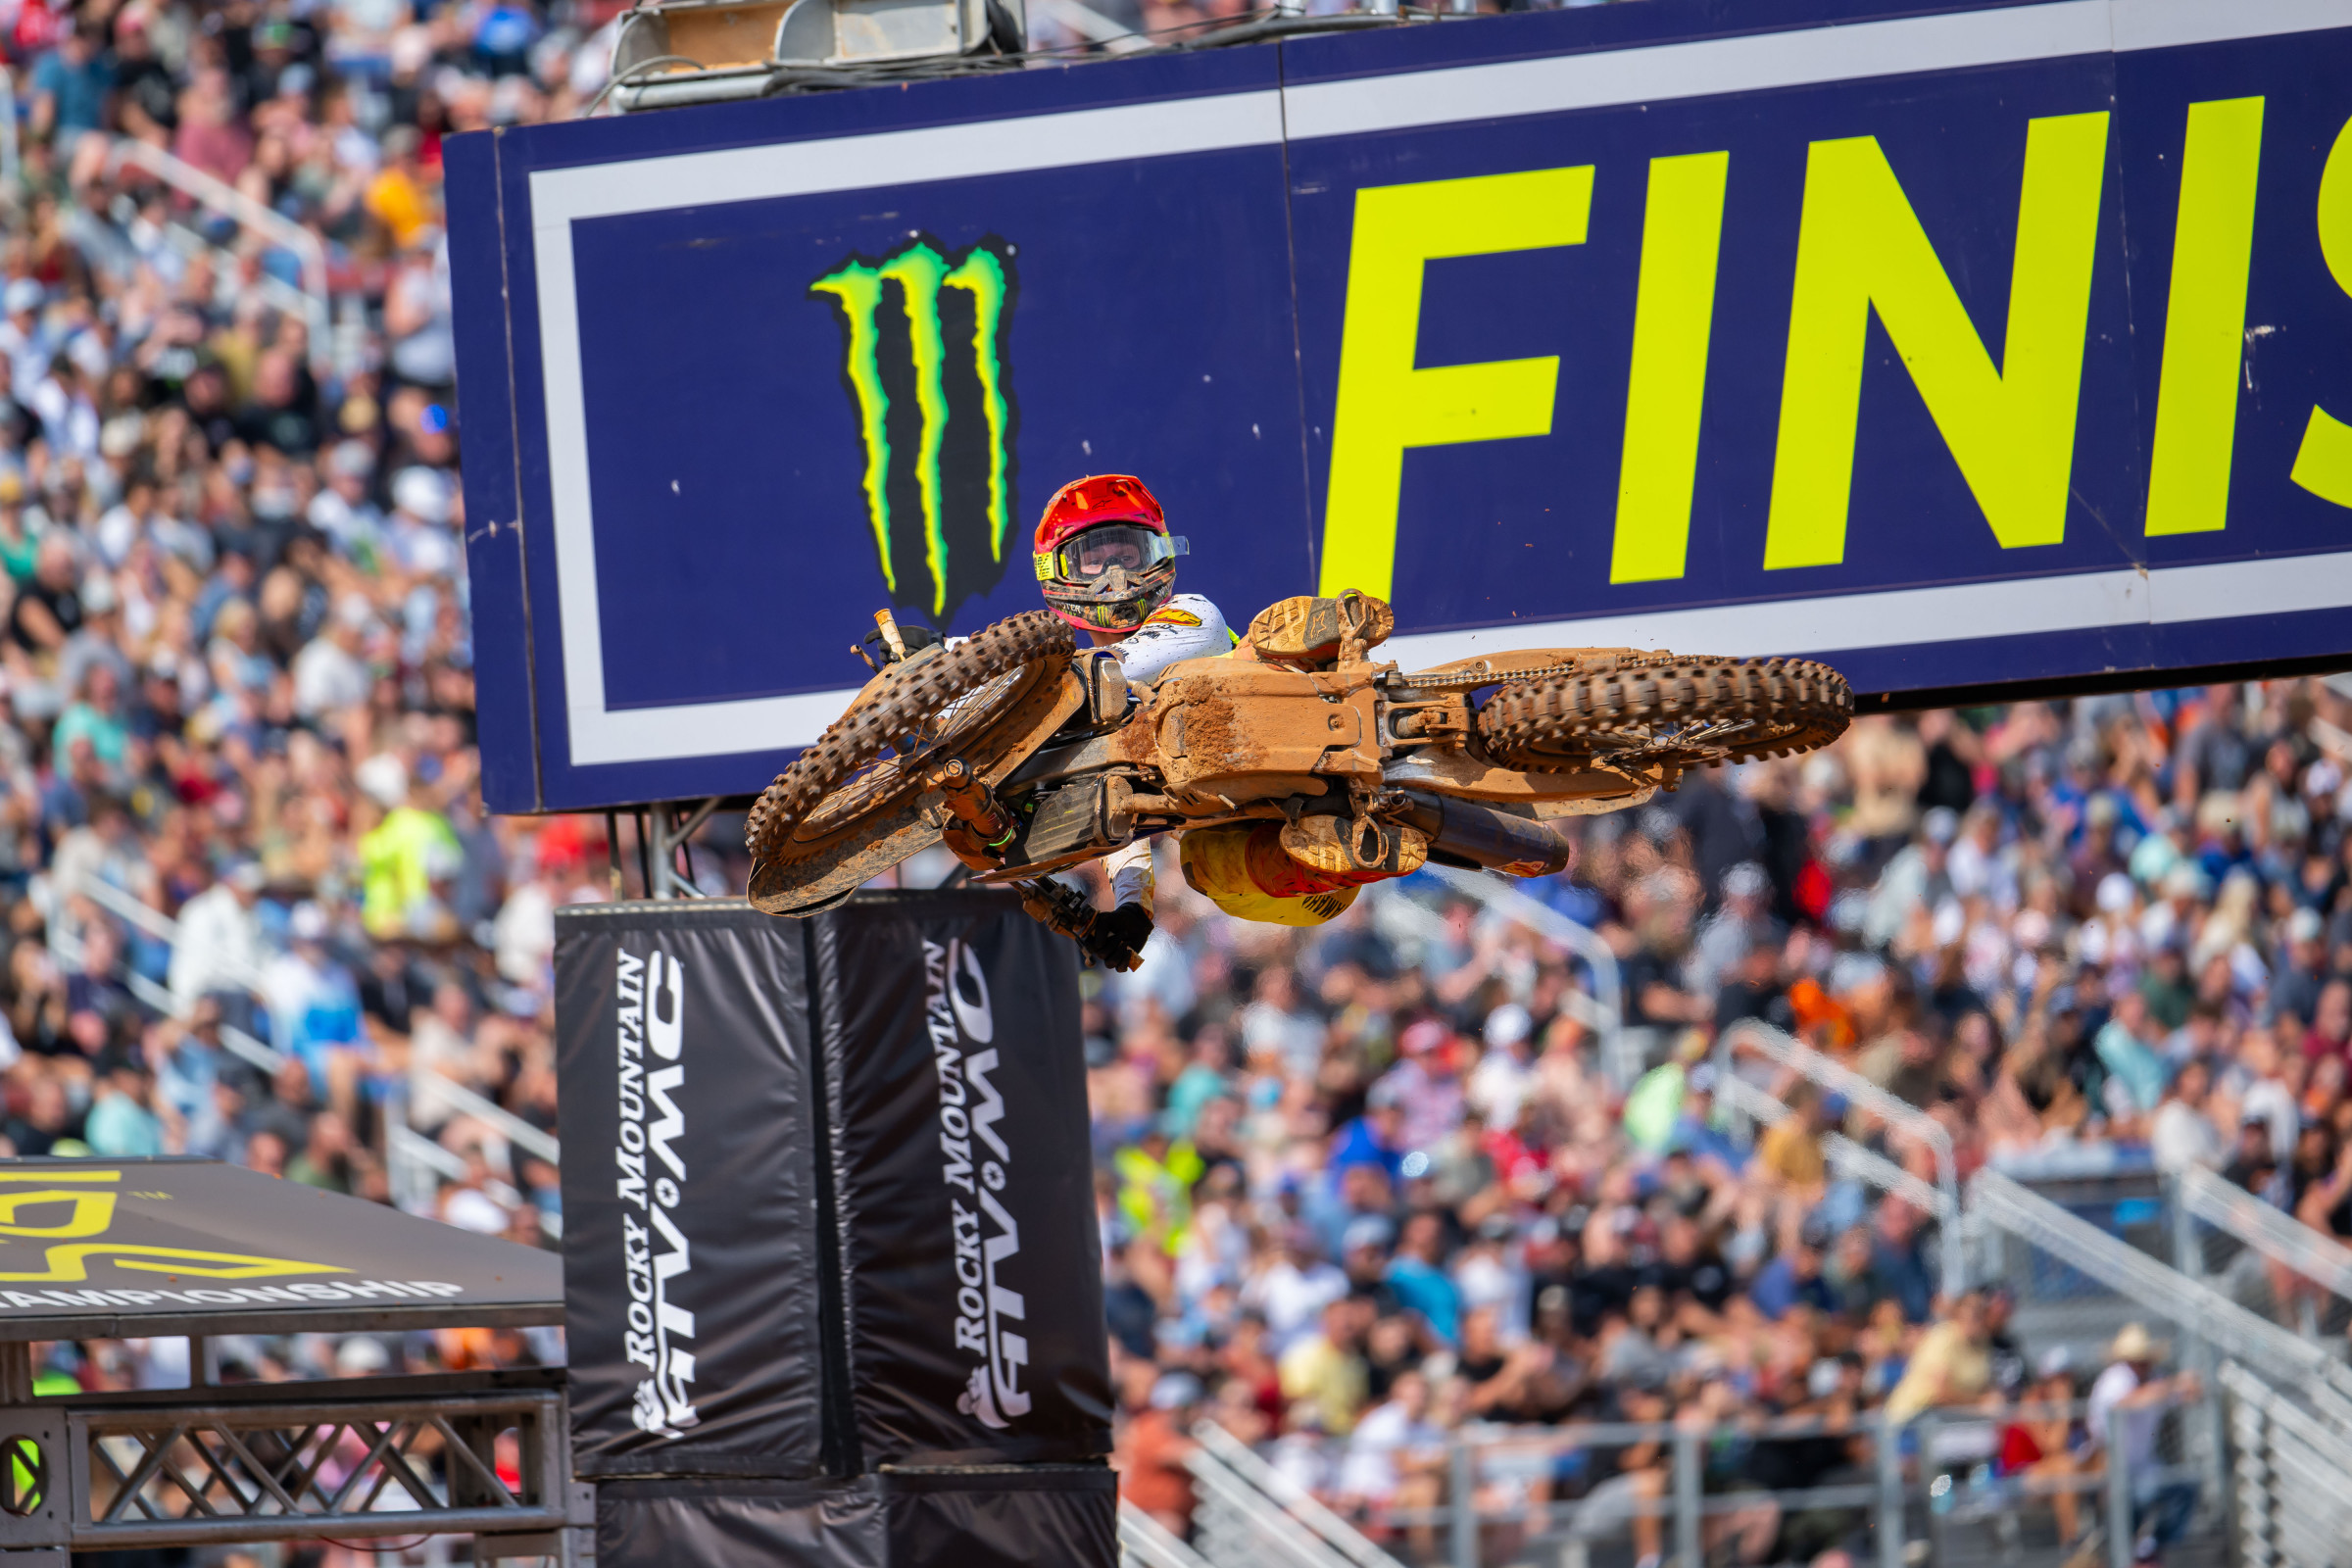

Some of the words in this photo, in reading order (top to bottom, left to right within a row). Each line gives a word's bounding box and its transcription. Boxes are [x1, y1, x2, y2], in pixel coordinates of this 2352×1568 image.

[1300, 894, 1349, 920] AMAHA
[615, 947, 647, 1211] MOUNTAIN
[920, 938, 975, 1195] MOUNTAIN
[0, 1280, 466, 1309] AMPIONSHIP
[623, 1213, 657, 1371] ROCKY
[951, 1198, 987, 1358] ROCKY
